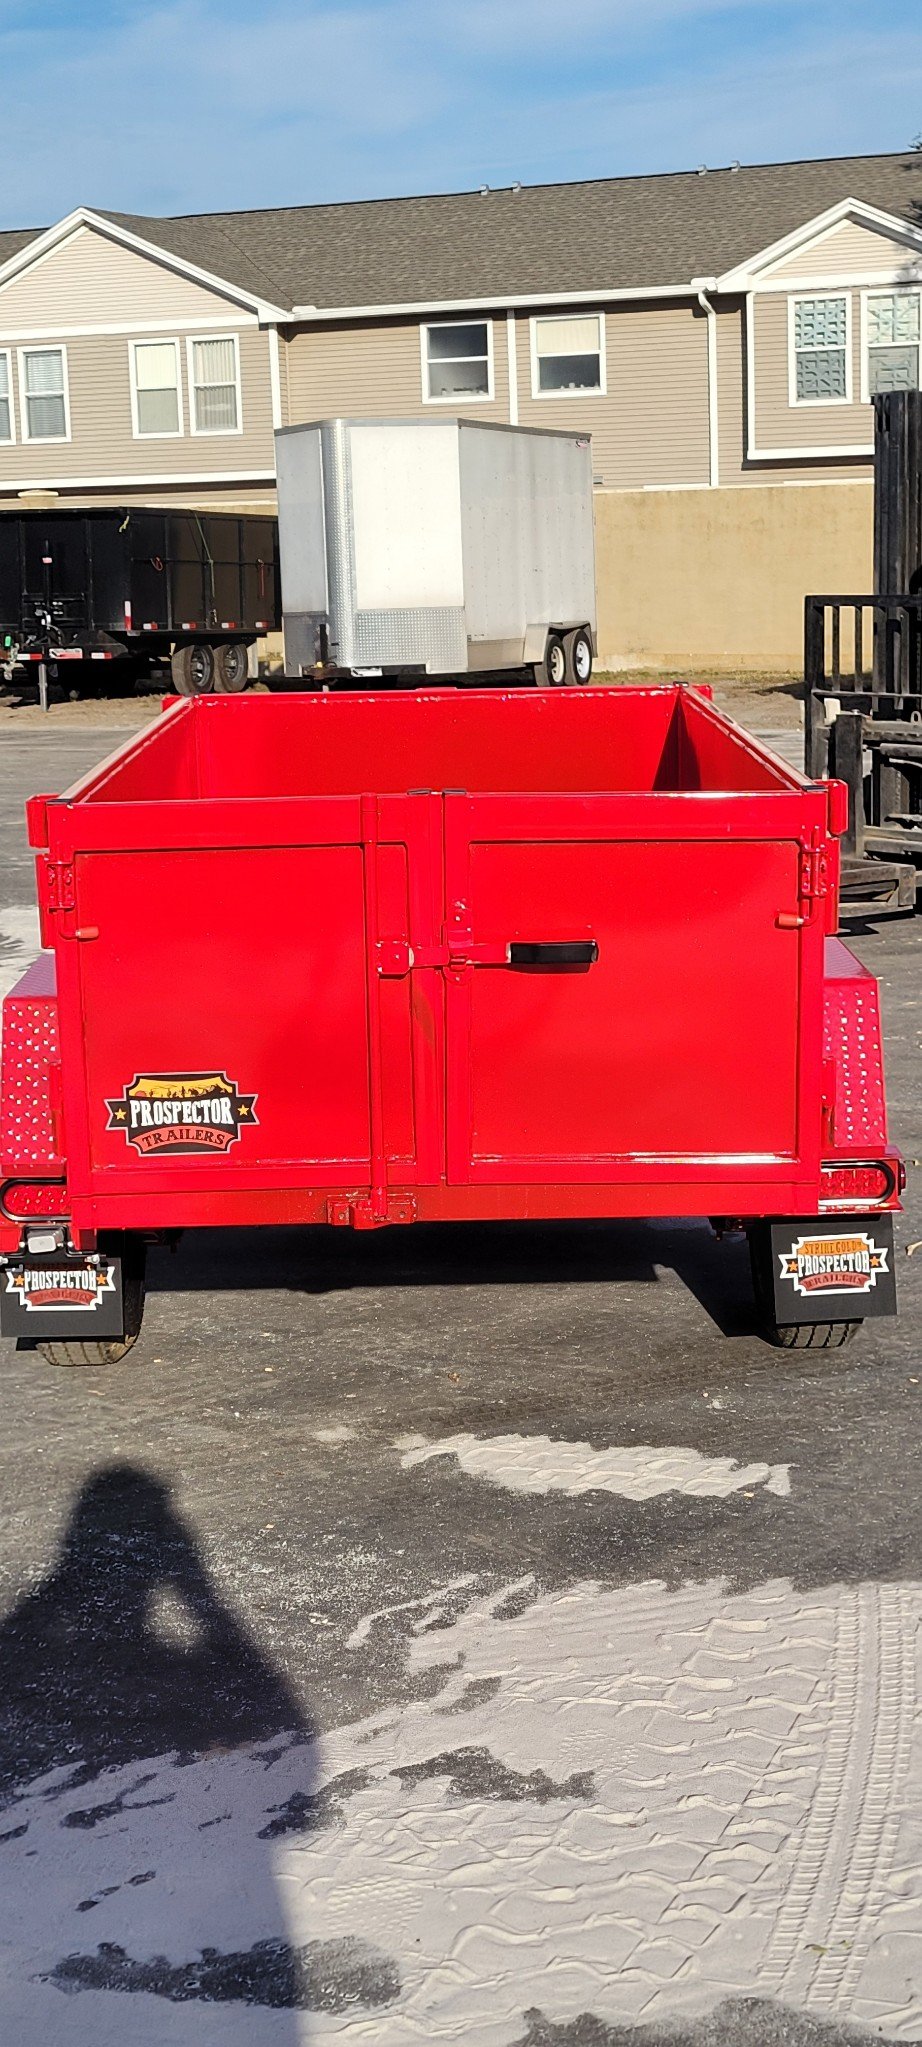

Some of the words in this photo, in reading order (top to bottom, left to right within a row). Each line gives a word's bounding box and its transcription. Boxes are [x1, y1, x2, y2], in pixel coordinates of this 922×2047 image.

[130, 1097, 234, 1128] PROSPECTOR
[142, 1128, 226, 1148] TRAILERS
[798, 1251, 870, 1278] PROSPECTOR
[24, 1270, 97, 1292] PROSPECTOR
